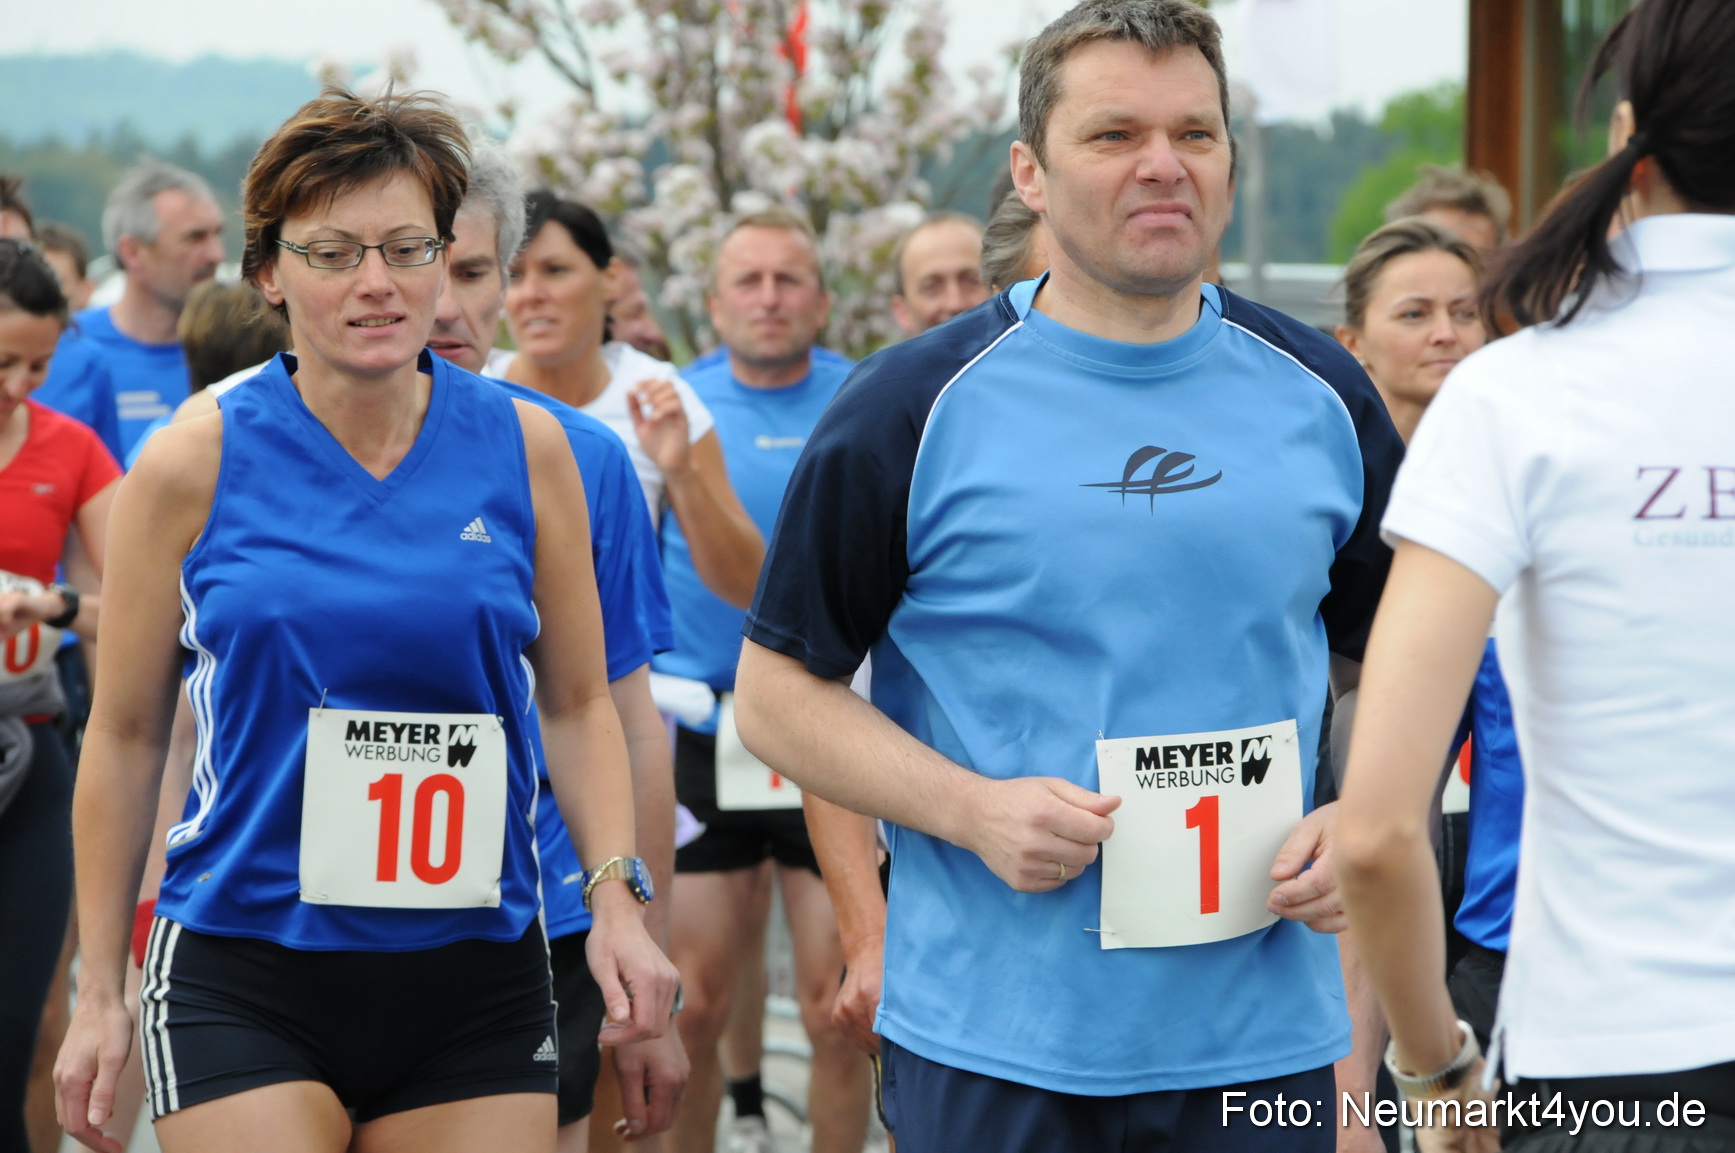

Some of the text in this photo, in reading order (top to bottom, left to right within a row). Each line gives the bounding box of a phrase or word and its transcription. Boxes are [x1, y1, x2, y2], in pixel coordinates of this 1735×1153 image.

[460, 532, 491, 543] adidas
[345, 720, 441, 745] MEYER
[345, 743, 441, 763] WERBUNG
[1135, 741, 1235, 771] MEYER
[1135, 767, 1235, 790] WERBUNG
[367, 773, 465, 885] 10
[1185, 795, 1220, 915] 1
